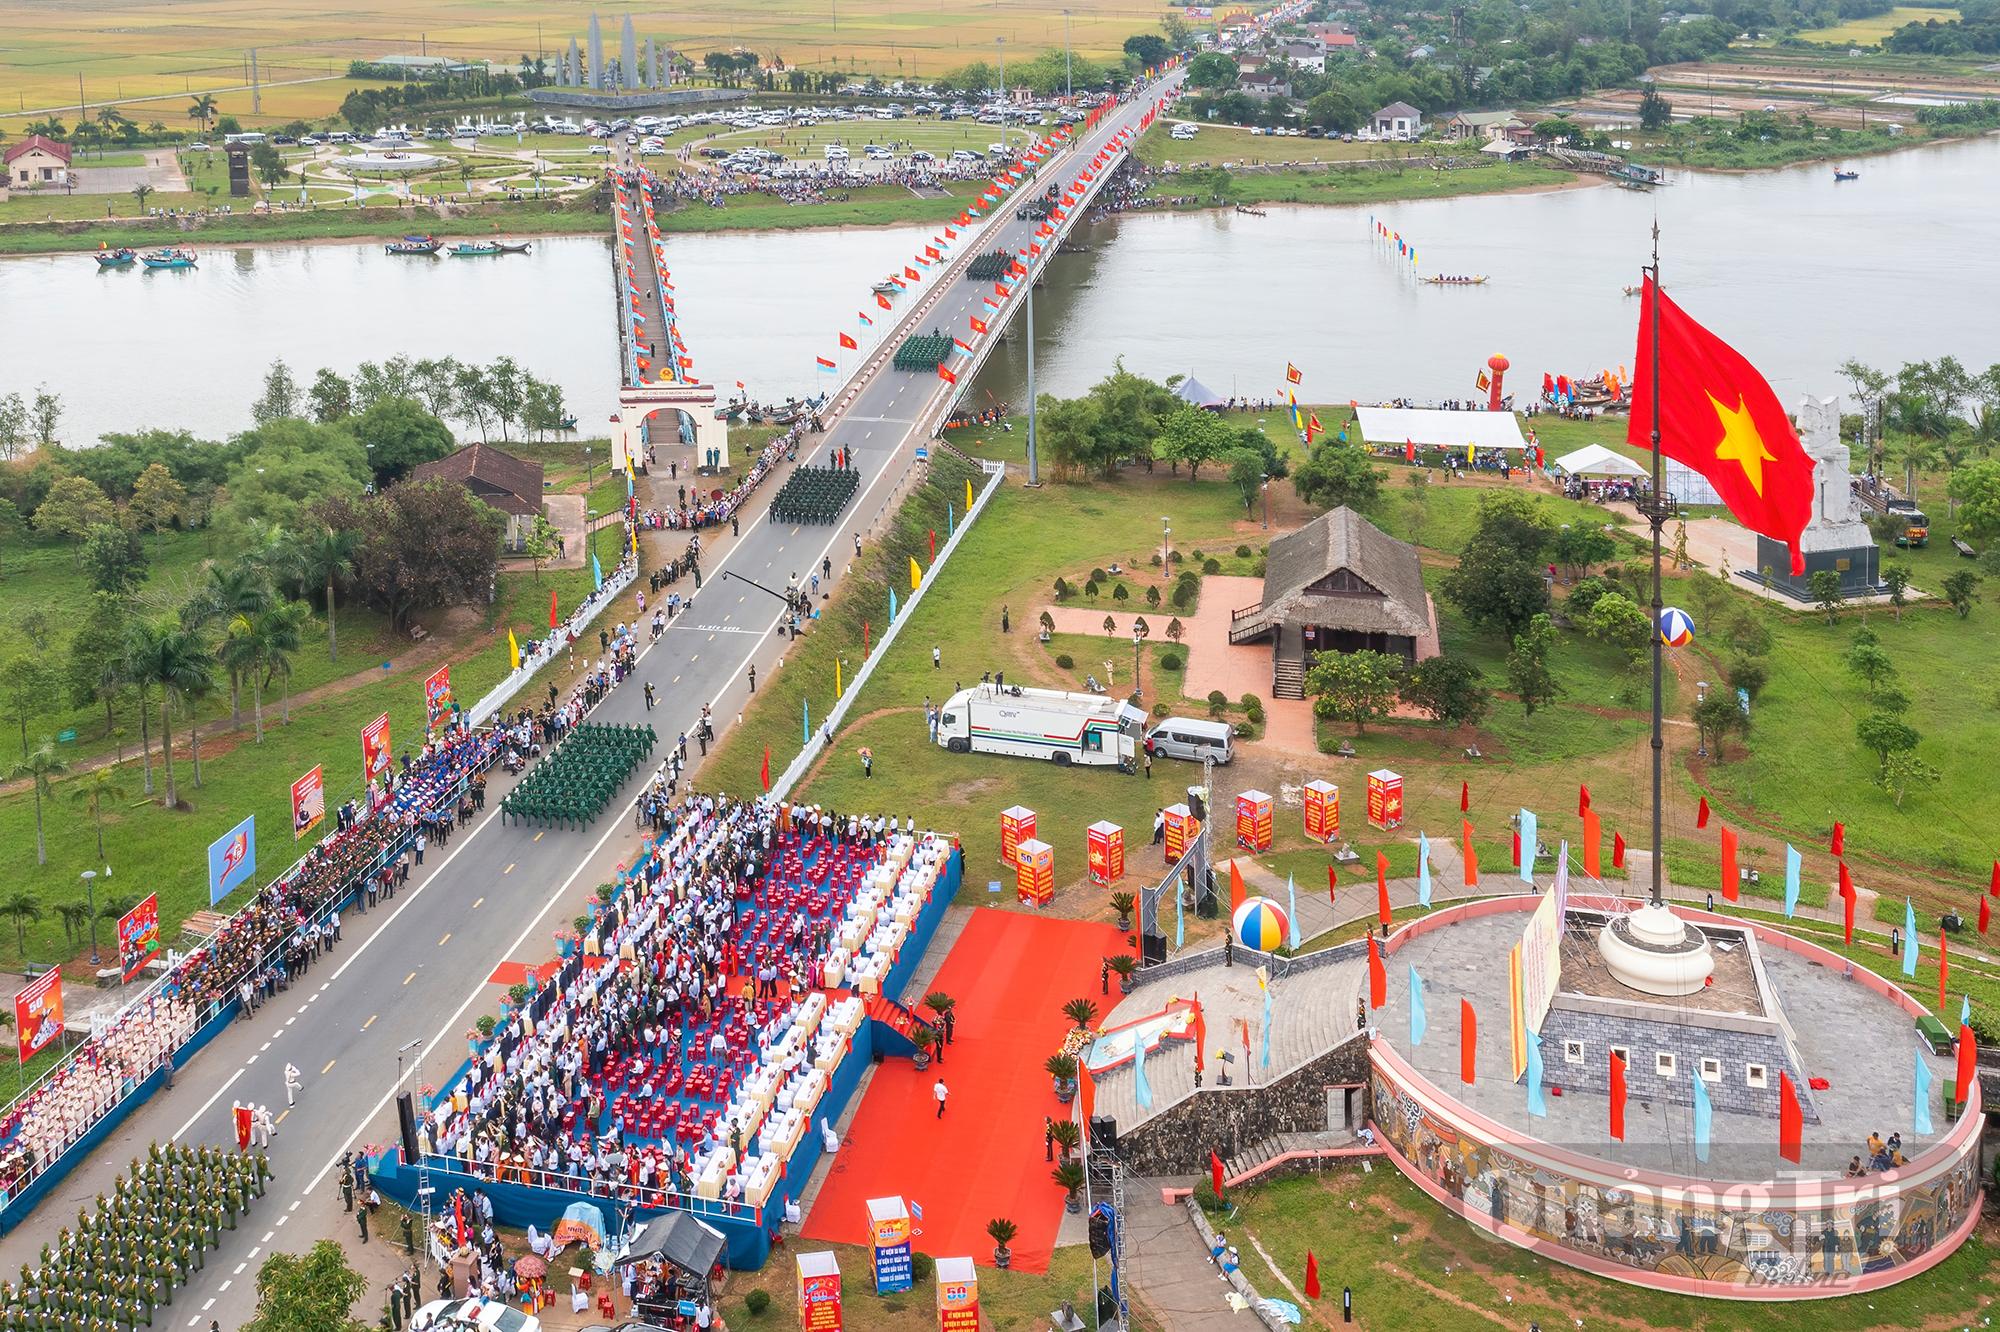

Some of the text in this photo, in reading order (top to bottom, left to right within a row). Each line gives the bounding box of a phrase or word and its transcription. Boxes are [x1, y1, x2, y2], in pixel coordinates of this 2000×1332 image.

[1020, 852, 1033, 864] 50
[28, 996, 44, 1014] 50
[810, 1289, 828, 1302] 50
[946, 1286, 968, 1301] 50
